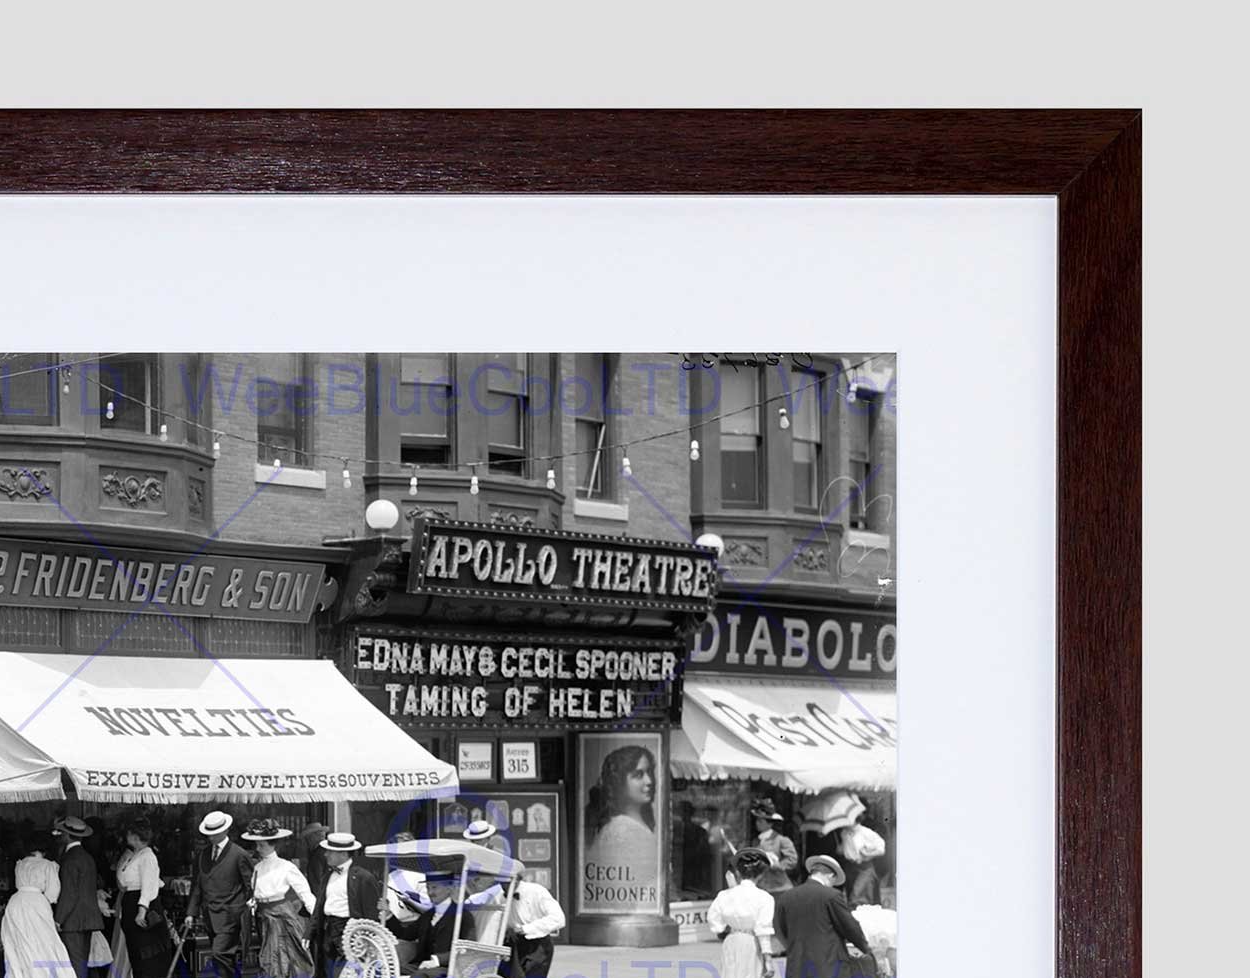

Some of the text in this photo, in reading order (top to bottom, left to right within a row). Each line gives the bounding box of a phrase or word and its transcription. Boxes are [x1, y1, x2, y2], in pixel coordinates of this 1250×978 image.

[12, 552, 215, 607] FRIDENBERG
[221, 568, 244, 609] &
[250, 570, 312, 613] SON
[426, 535, 714, 598] APOLLO THEATRE
[689, 611, 897, 673] DIABOLO
[356, 637, 424, 675] EDNA
[501, 647, 575, 679] CECIL
[575, 649, 677, 681] SPOONER
[385, 683, 635, 719] TAMING OF HELEN
[83, 706, 317, 737] NOVELTIES
[85, 770, 210, 789] EXCLUSIVE
[584, 862, 635, 881] CECIL
[584, 882, 656, 901] SPOONER
[675, 911, 708, 926] DIA
